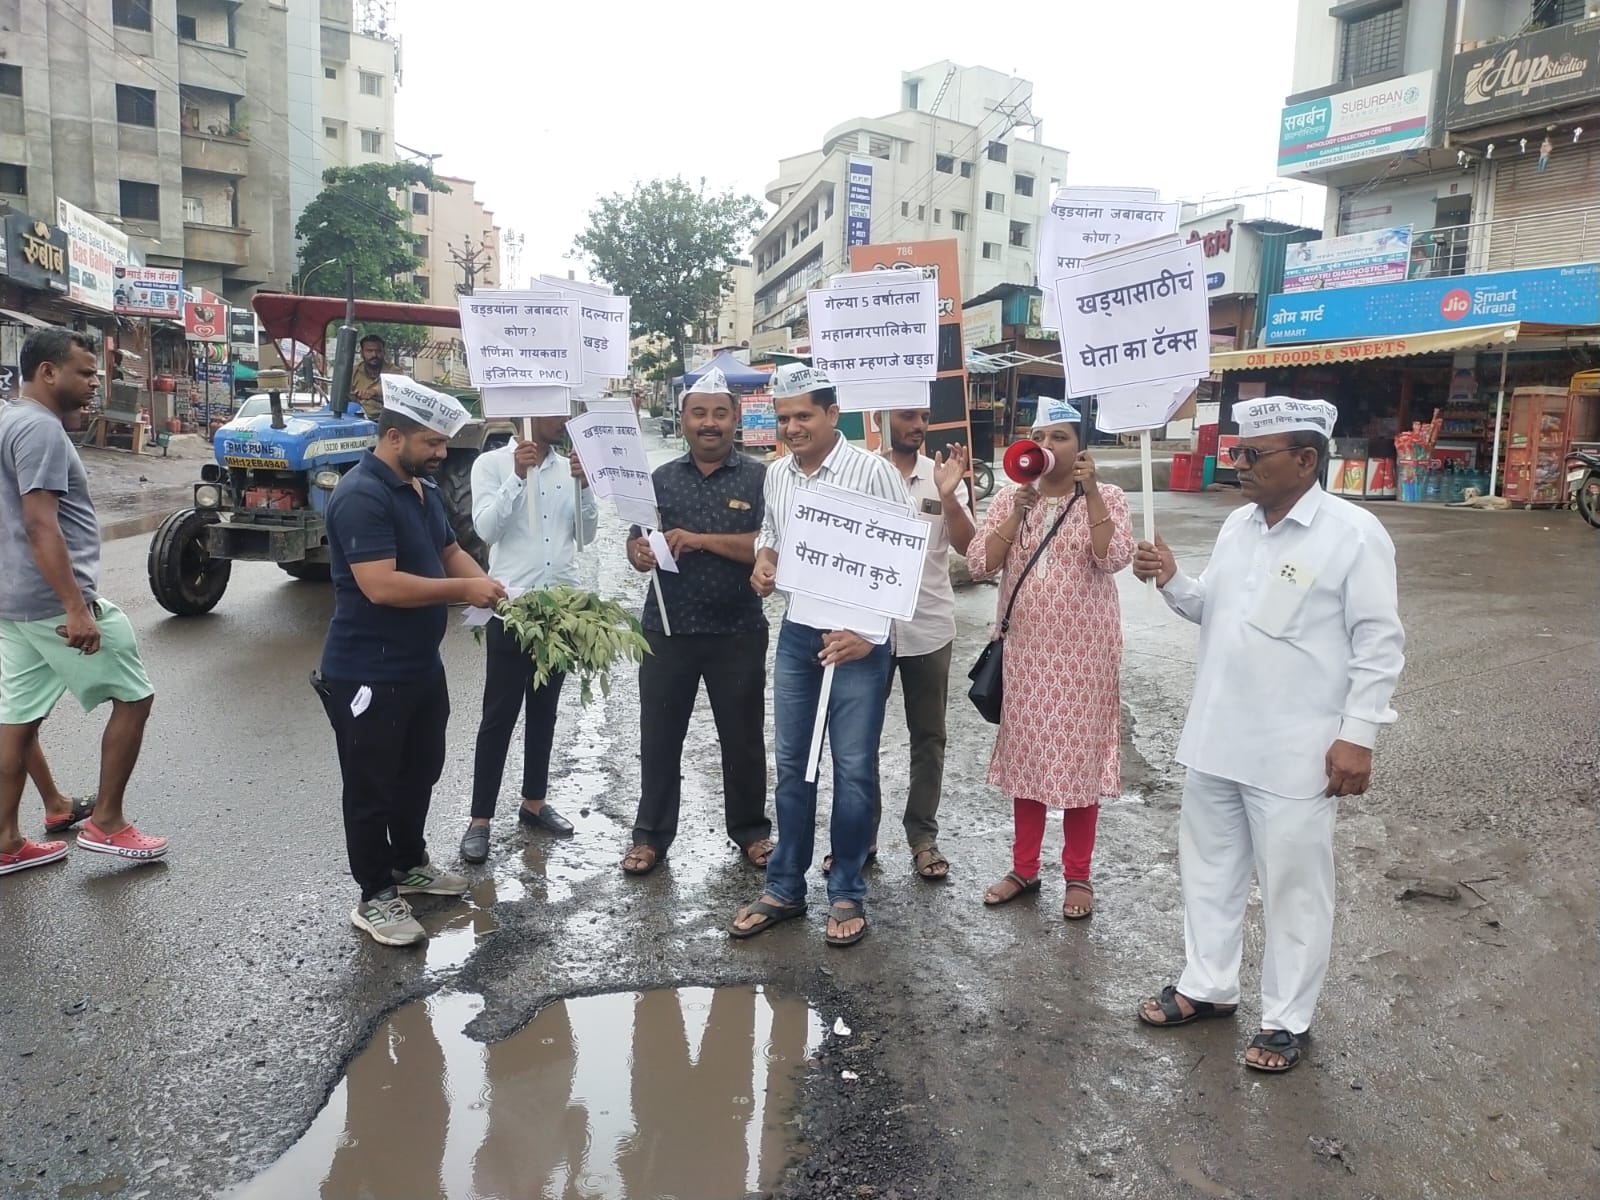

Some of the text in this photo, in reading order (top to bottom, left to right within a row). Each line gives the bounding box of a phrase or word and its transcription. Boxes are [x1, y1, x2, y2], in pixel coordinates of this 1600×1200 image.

[1341, 90, 1403, 114] SUBURBAN
[1284, 105, 1328, 131] सबर्बन
[1110, 208, 1166, 223] जबाबदार
[1082, 230, 1111, 245] कोण
[896, 246, 913, 257] 786
[1332, 264, 1389, 278] DIAGNOSTICS
[824, 296, 859, 311] गेल्या
[862, 296, 869, 308] 5
[1474, 288, 1518, 304] Smart
[524, 305, 569, 316] जबाबदार
[1443, 296, 1468, 313] Jio
[1472, 303, 1516, 315] Kirana
[1271, 304, 1326, 325] ओम मार्ट
[504, 325, 528, 337] कोण
[821, 320, 927, 343] महानगरपालिकेचा
[1270, 328, 1307, 339] OM MART
[583, 335, 610, 353] खड्डे
[1079, 326, 1199, 368] घेता का टॅक्स
[519, 348, 568, 359] गायकवाड
[1246, 340, 1407, 367] OM FOODS & SWEETS
[816, 352, 934, 372] विकास म्हणजे खड्डा
[790, 369, 811, 383] आम
[400, 387, 438, 409] आदमी
[439, 402, 464, 421] पार्टी
[1248, 402, 1281, 417] आम
[249, 443, 275, 456] PUNE
[795, 504, 925, 551] आमच्या टॅक्सचा
[795, 540, 902, 590] पैसा गेला कुठे.
[118, 848, 153, 857] crocs
